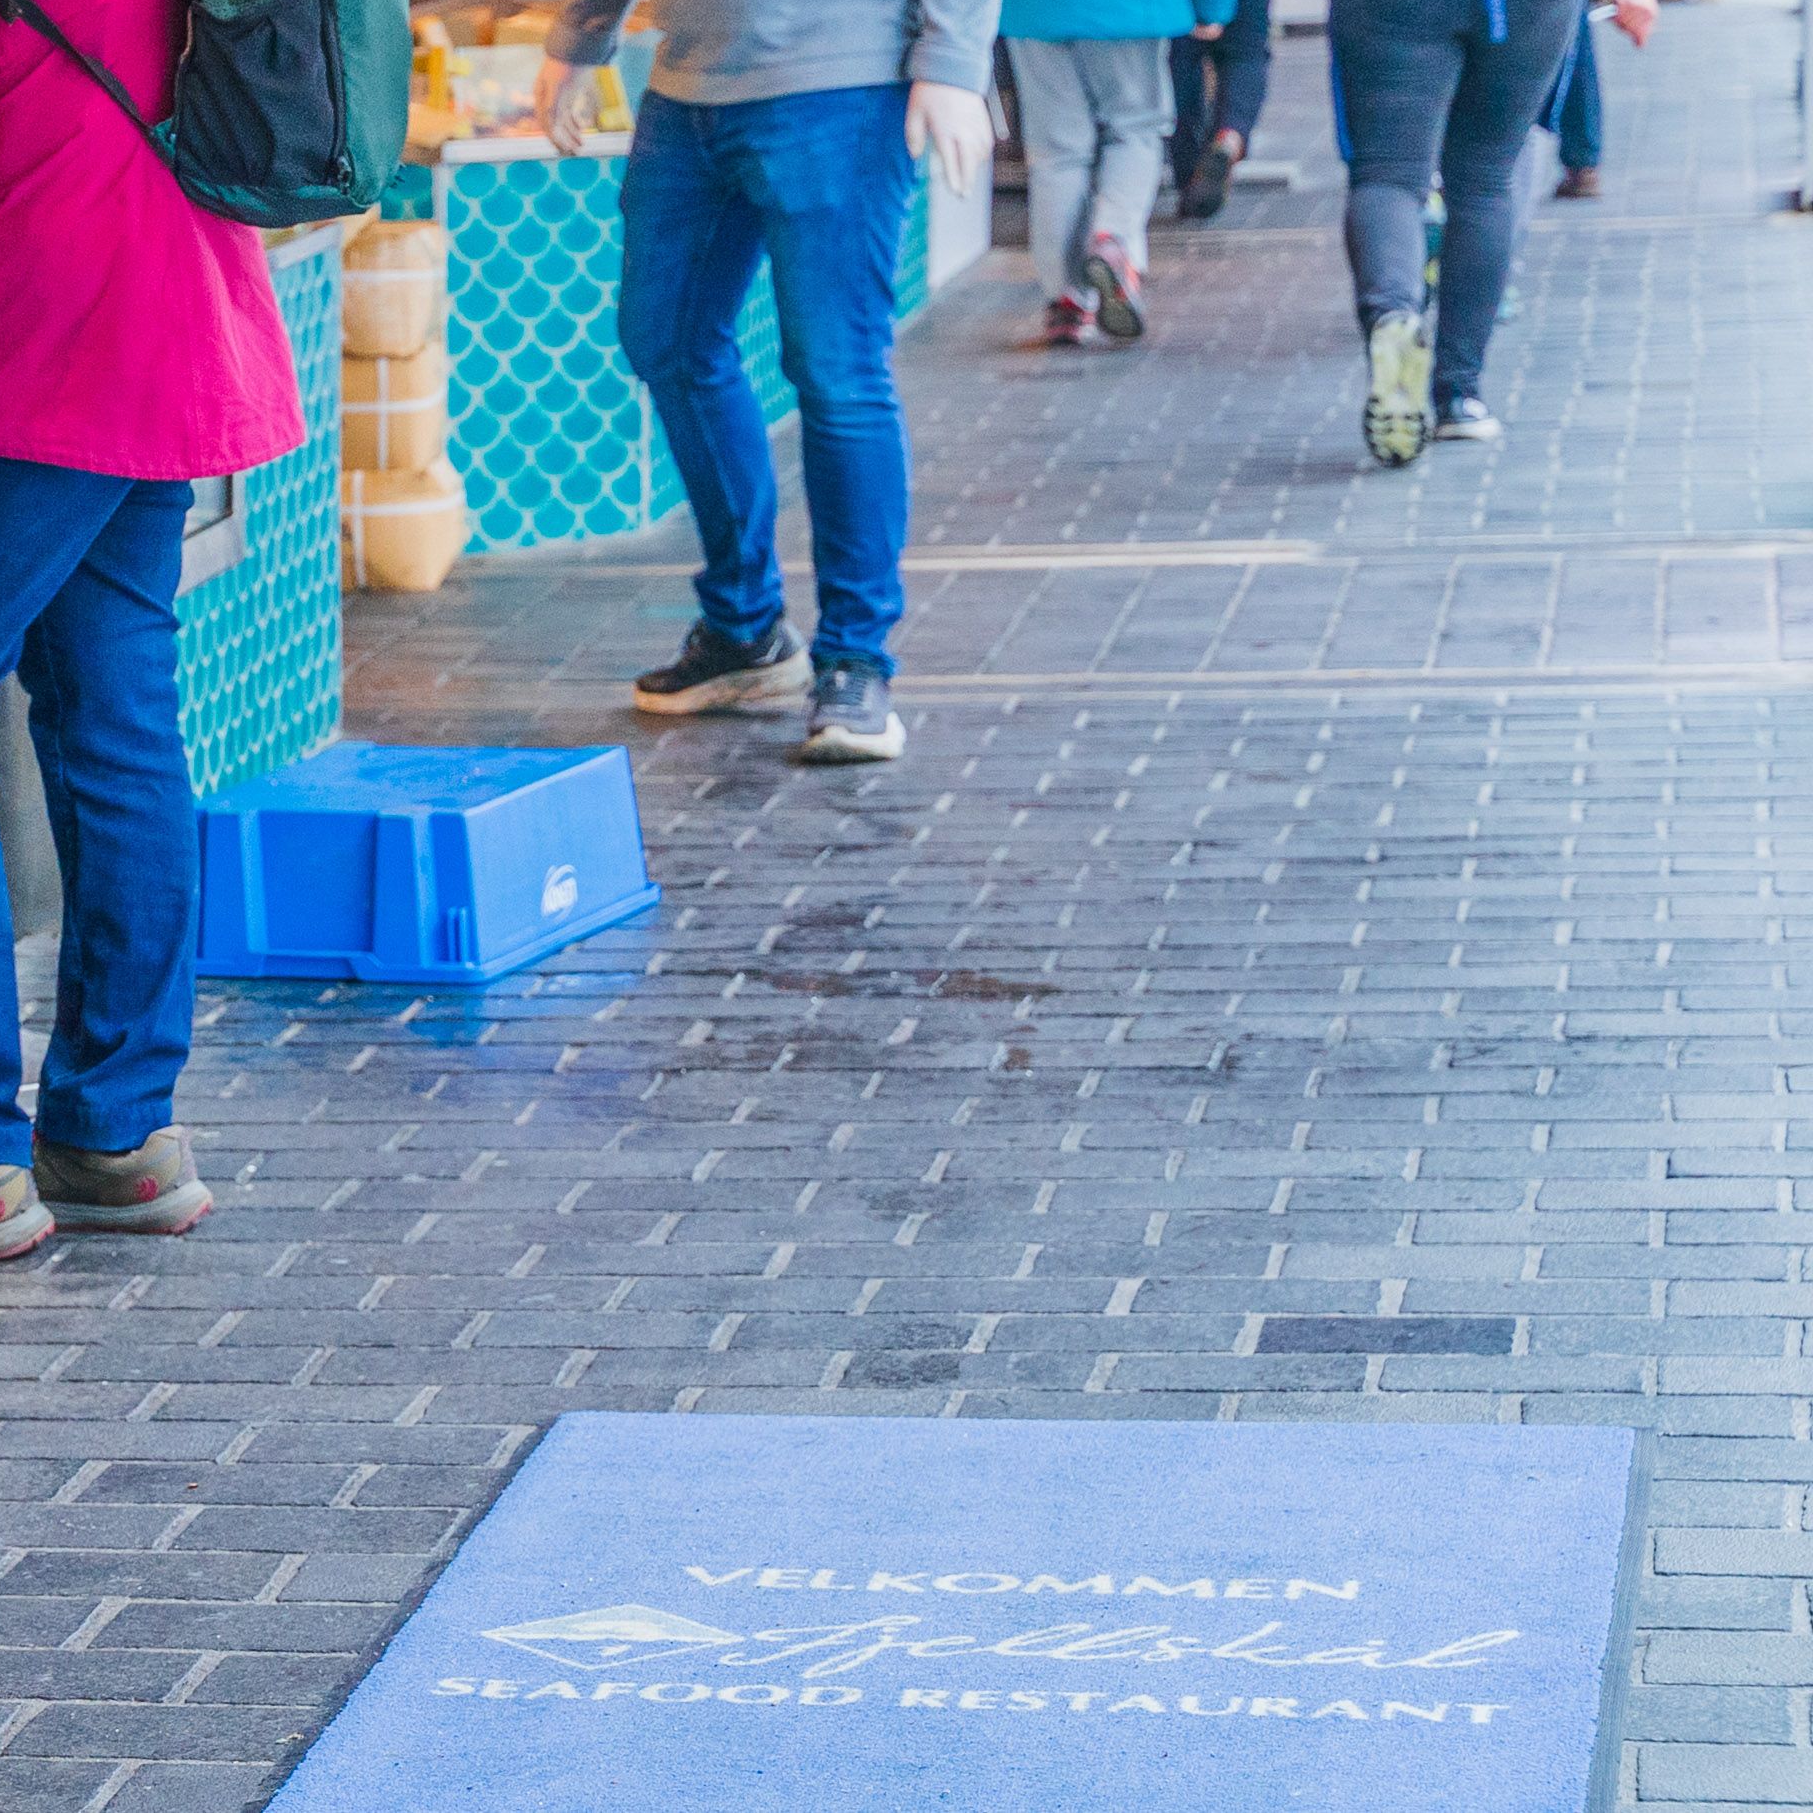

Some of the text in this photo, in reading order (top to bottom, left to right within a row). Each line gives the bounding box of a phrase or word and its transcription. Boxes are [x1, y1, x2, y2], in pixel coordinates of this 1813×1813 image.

[684, 1565, 1361, 1601] VELKOMMEN
[718, 1613, 1522, 1680] Fjellskål
[430, 1675, 1512, 1726] SEAFOOD RESTAURANT
